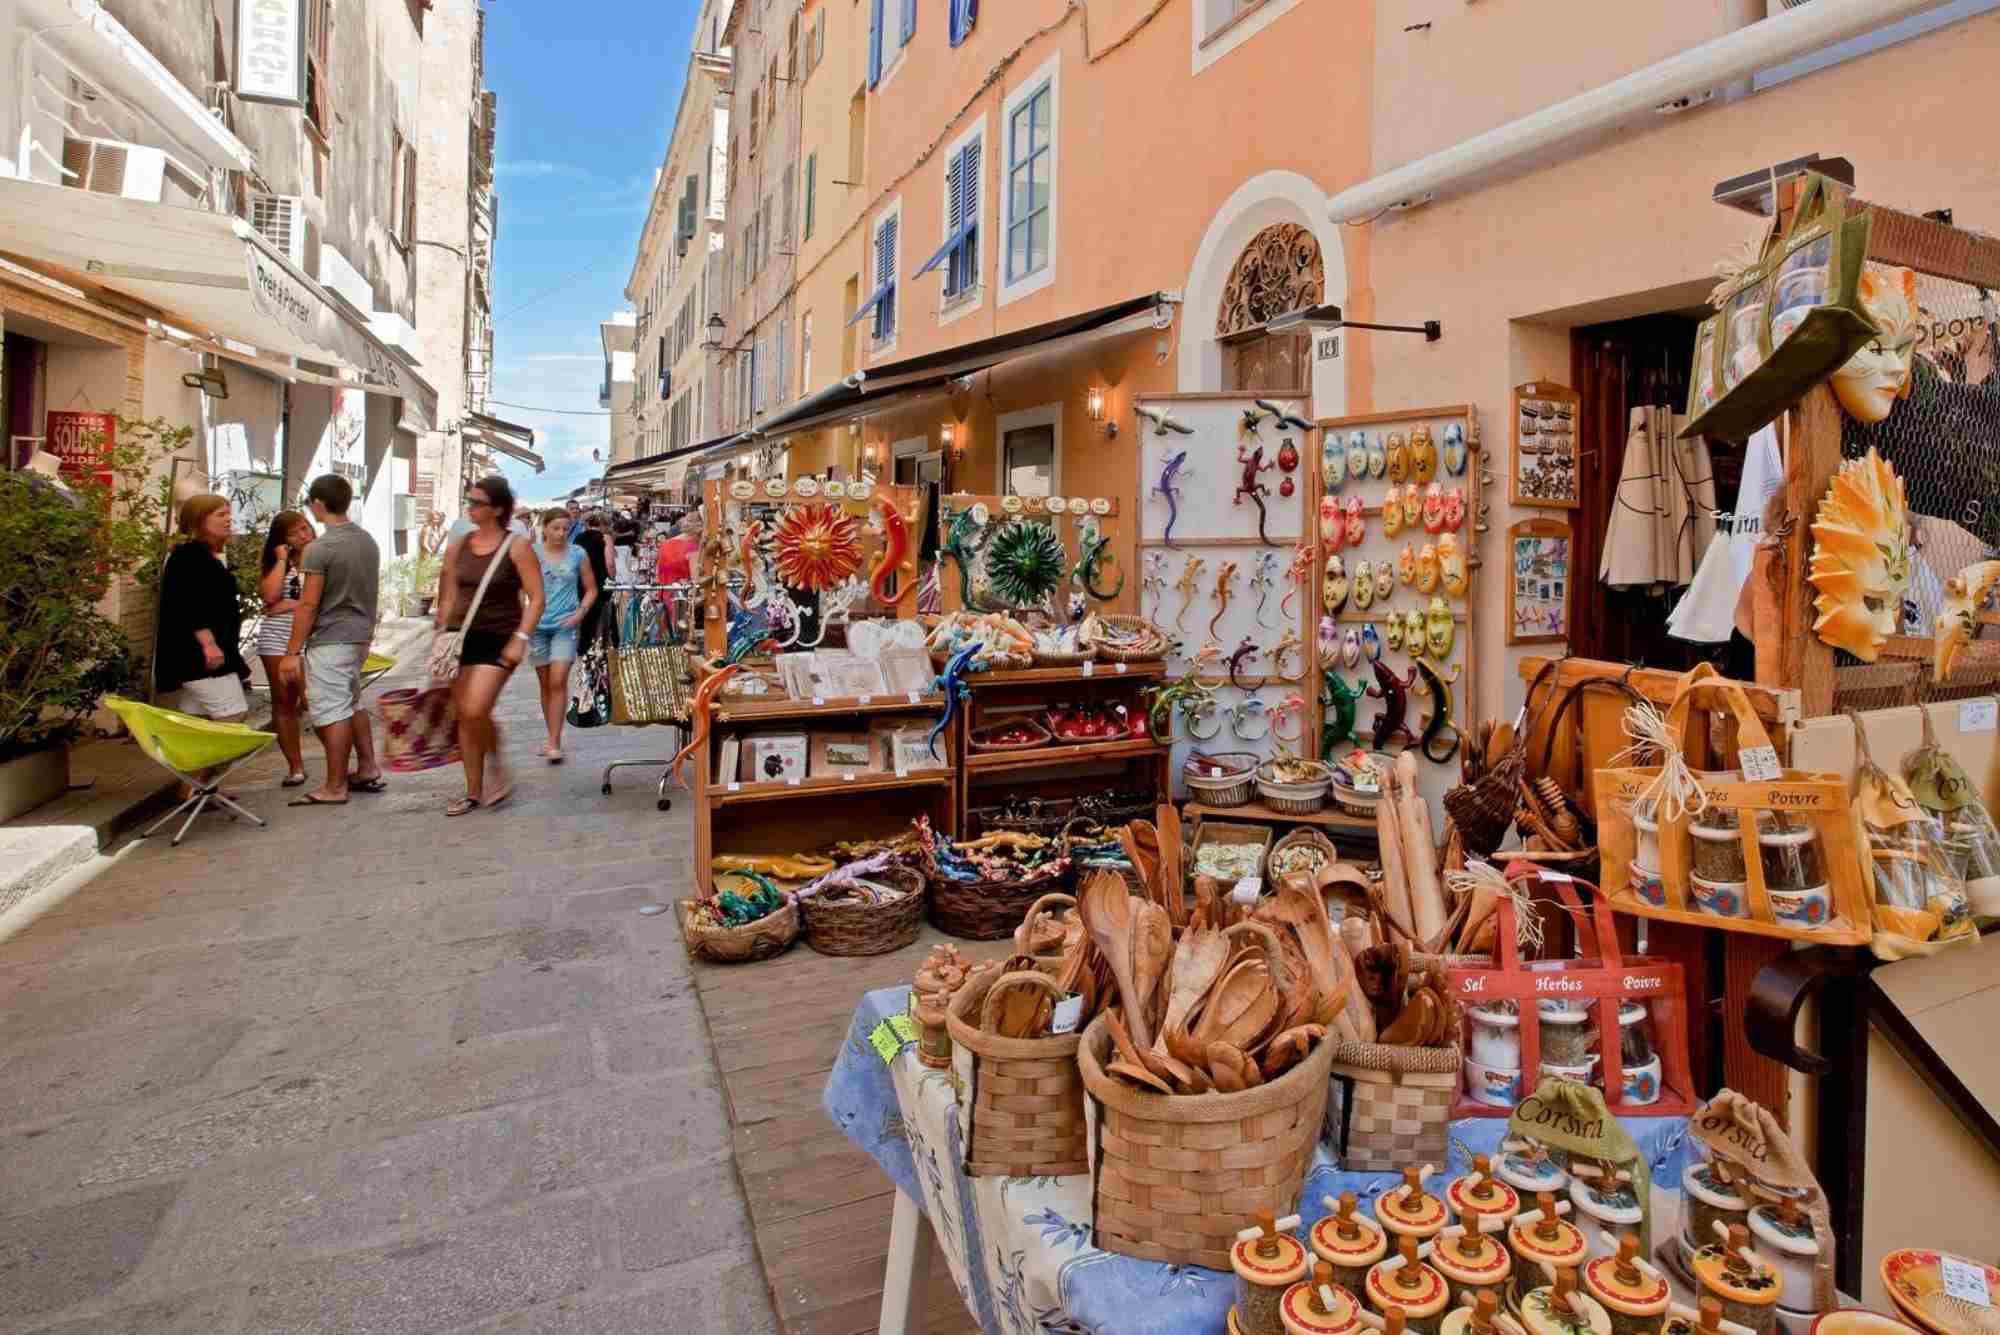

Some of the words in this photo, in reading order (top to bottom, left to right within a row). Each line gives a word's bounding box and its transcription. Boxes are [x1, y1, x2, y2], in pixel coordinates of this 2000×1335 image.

[53, 425, 105, 454] SOLDE
[62, 455, 105, 465] OLDES
[1767, 790, 1820, 806] Poivre
[1461, 975, 1488, 992] Sel
[1535, 975, 1585, 992] Herbes
[1622, 975, 1664, 990] Poivre
